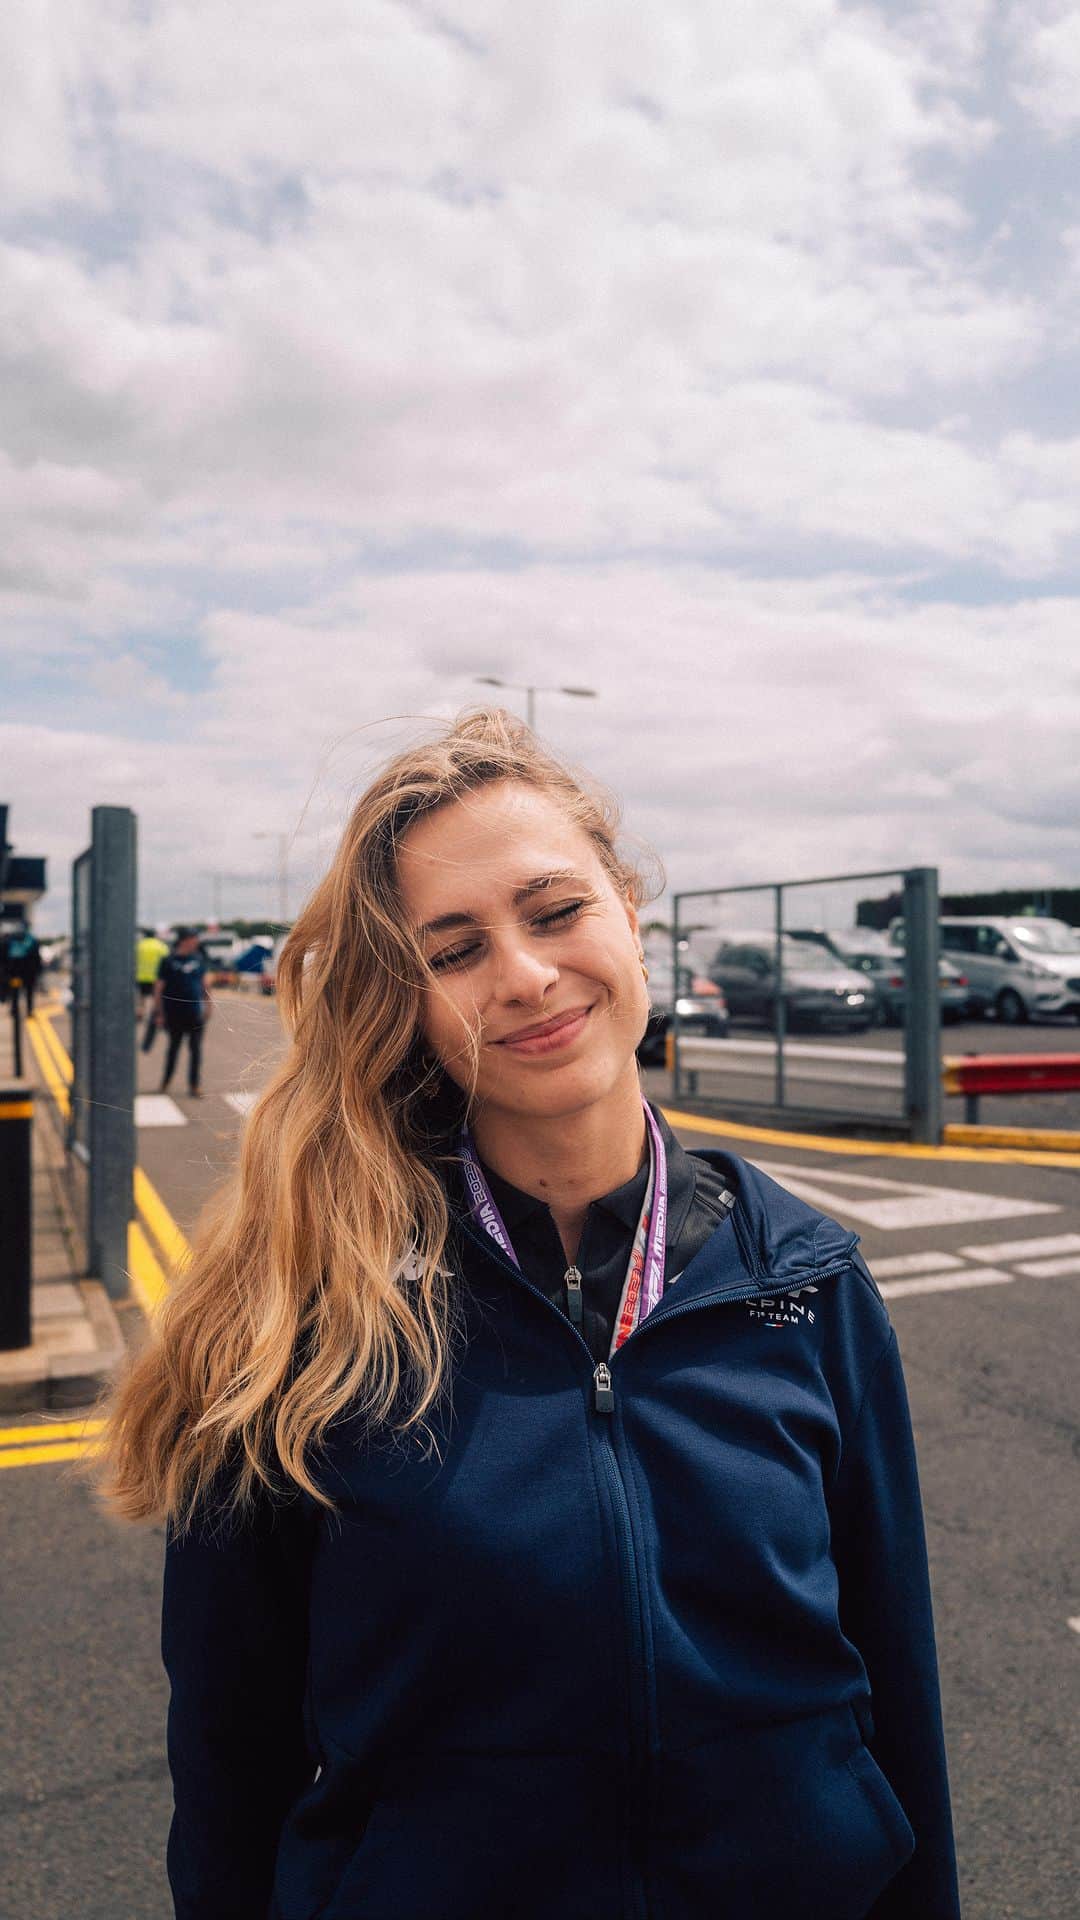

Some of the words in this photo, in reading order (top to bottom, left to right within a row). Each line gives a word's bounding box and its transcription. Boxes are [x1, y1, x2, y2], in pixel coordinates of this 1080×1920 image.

[479, 1202, 510, 1257] EDIA
[745, 1299, 815, 1324] LPINE
[768, 1313, 799, 1324] TEAM
